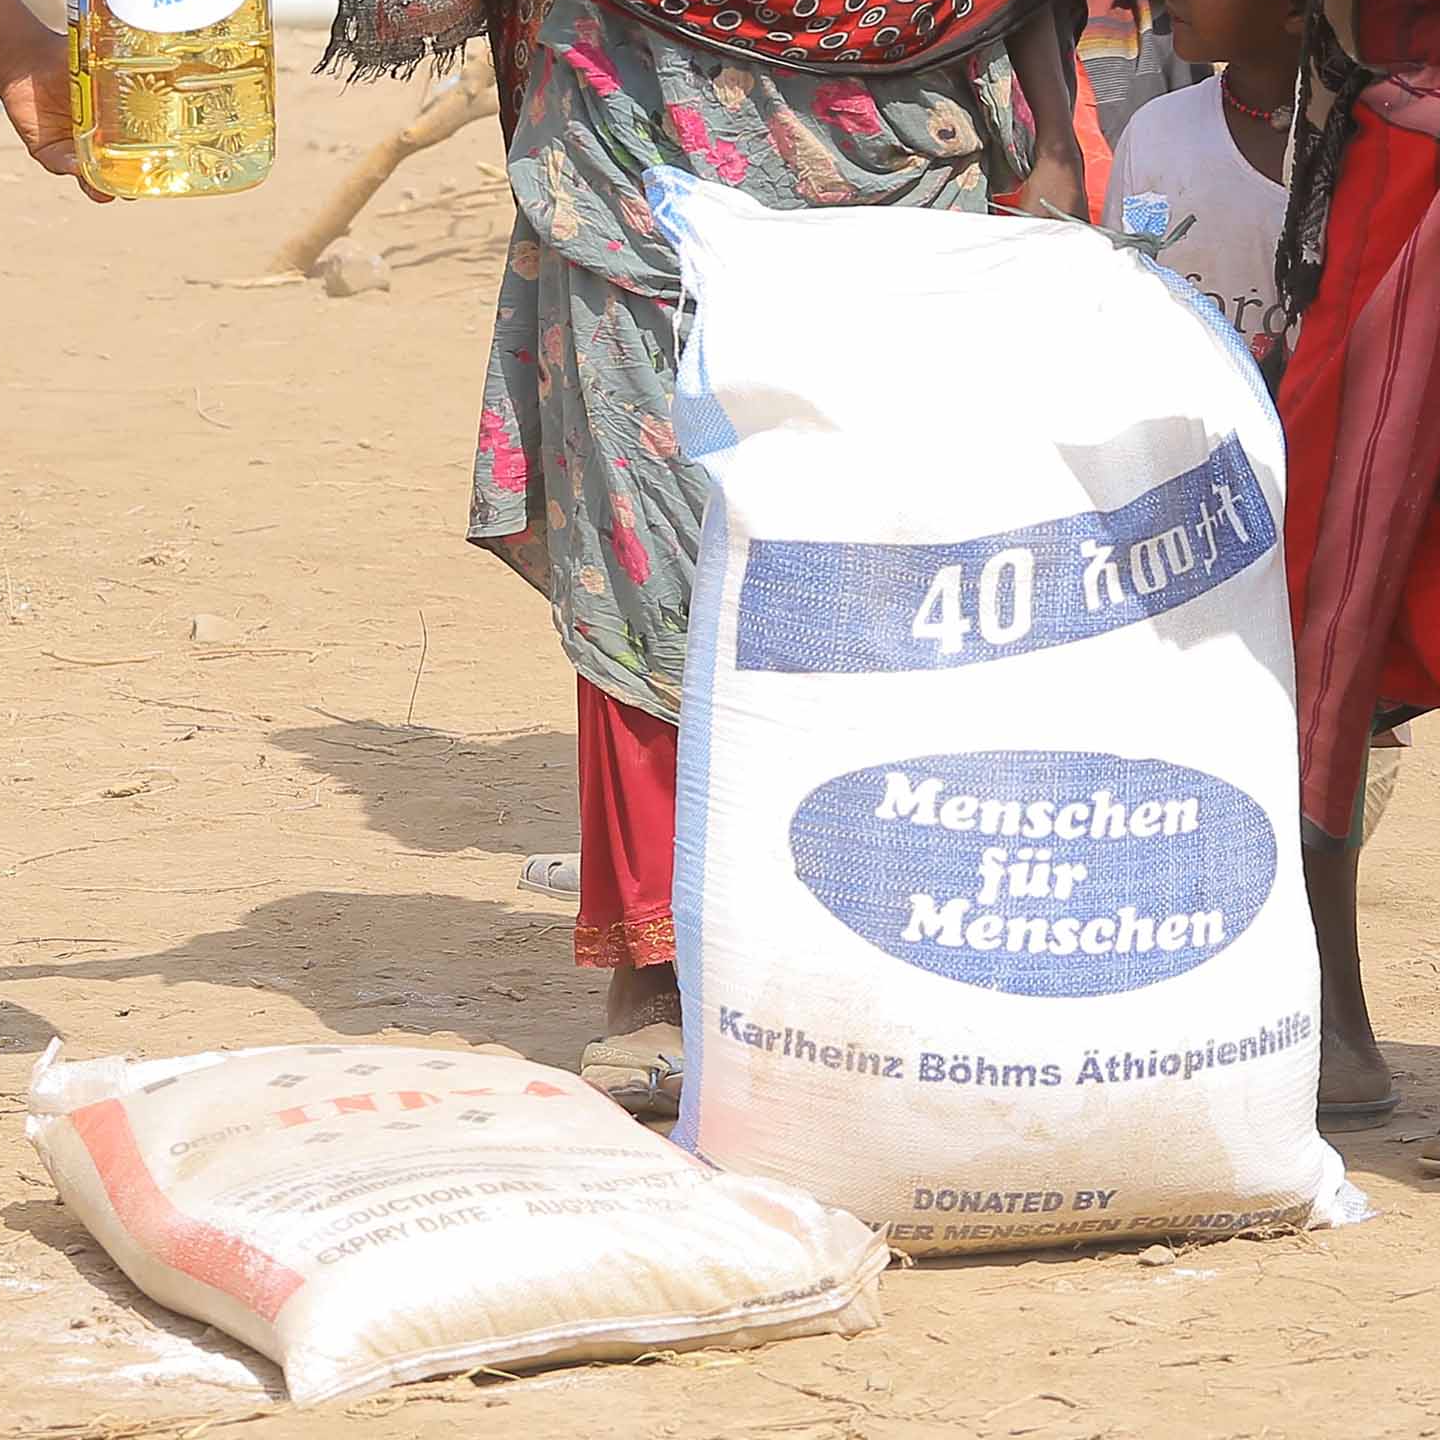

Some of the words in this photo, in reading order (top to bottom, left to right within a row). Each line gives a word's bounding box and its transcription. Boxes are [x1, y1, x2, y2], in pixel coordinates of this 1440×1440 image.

[912, 546, 1035, 656] 40
[874, 771, 1200, 841] Menschen
[976, 846, 1089, 905] für
[900, 892, 1227, 955] Menschen
[718, 1005, 905, 1080] Karlheinz
[918, 1051, 1062, 1088] Böhms
[1075, 1010, 1312, 1086] Äthiopienhilfe
[913, 1187, 1064, 1214] DONATED
[1071, 1188, 1119, 1211] BY
[943, 1217, 1122, 1241] MENSCHEN
[315, 1220, 411, 1265] EXPIRY
[414, 1205, 493, 1233] DATE
